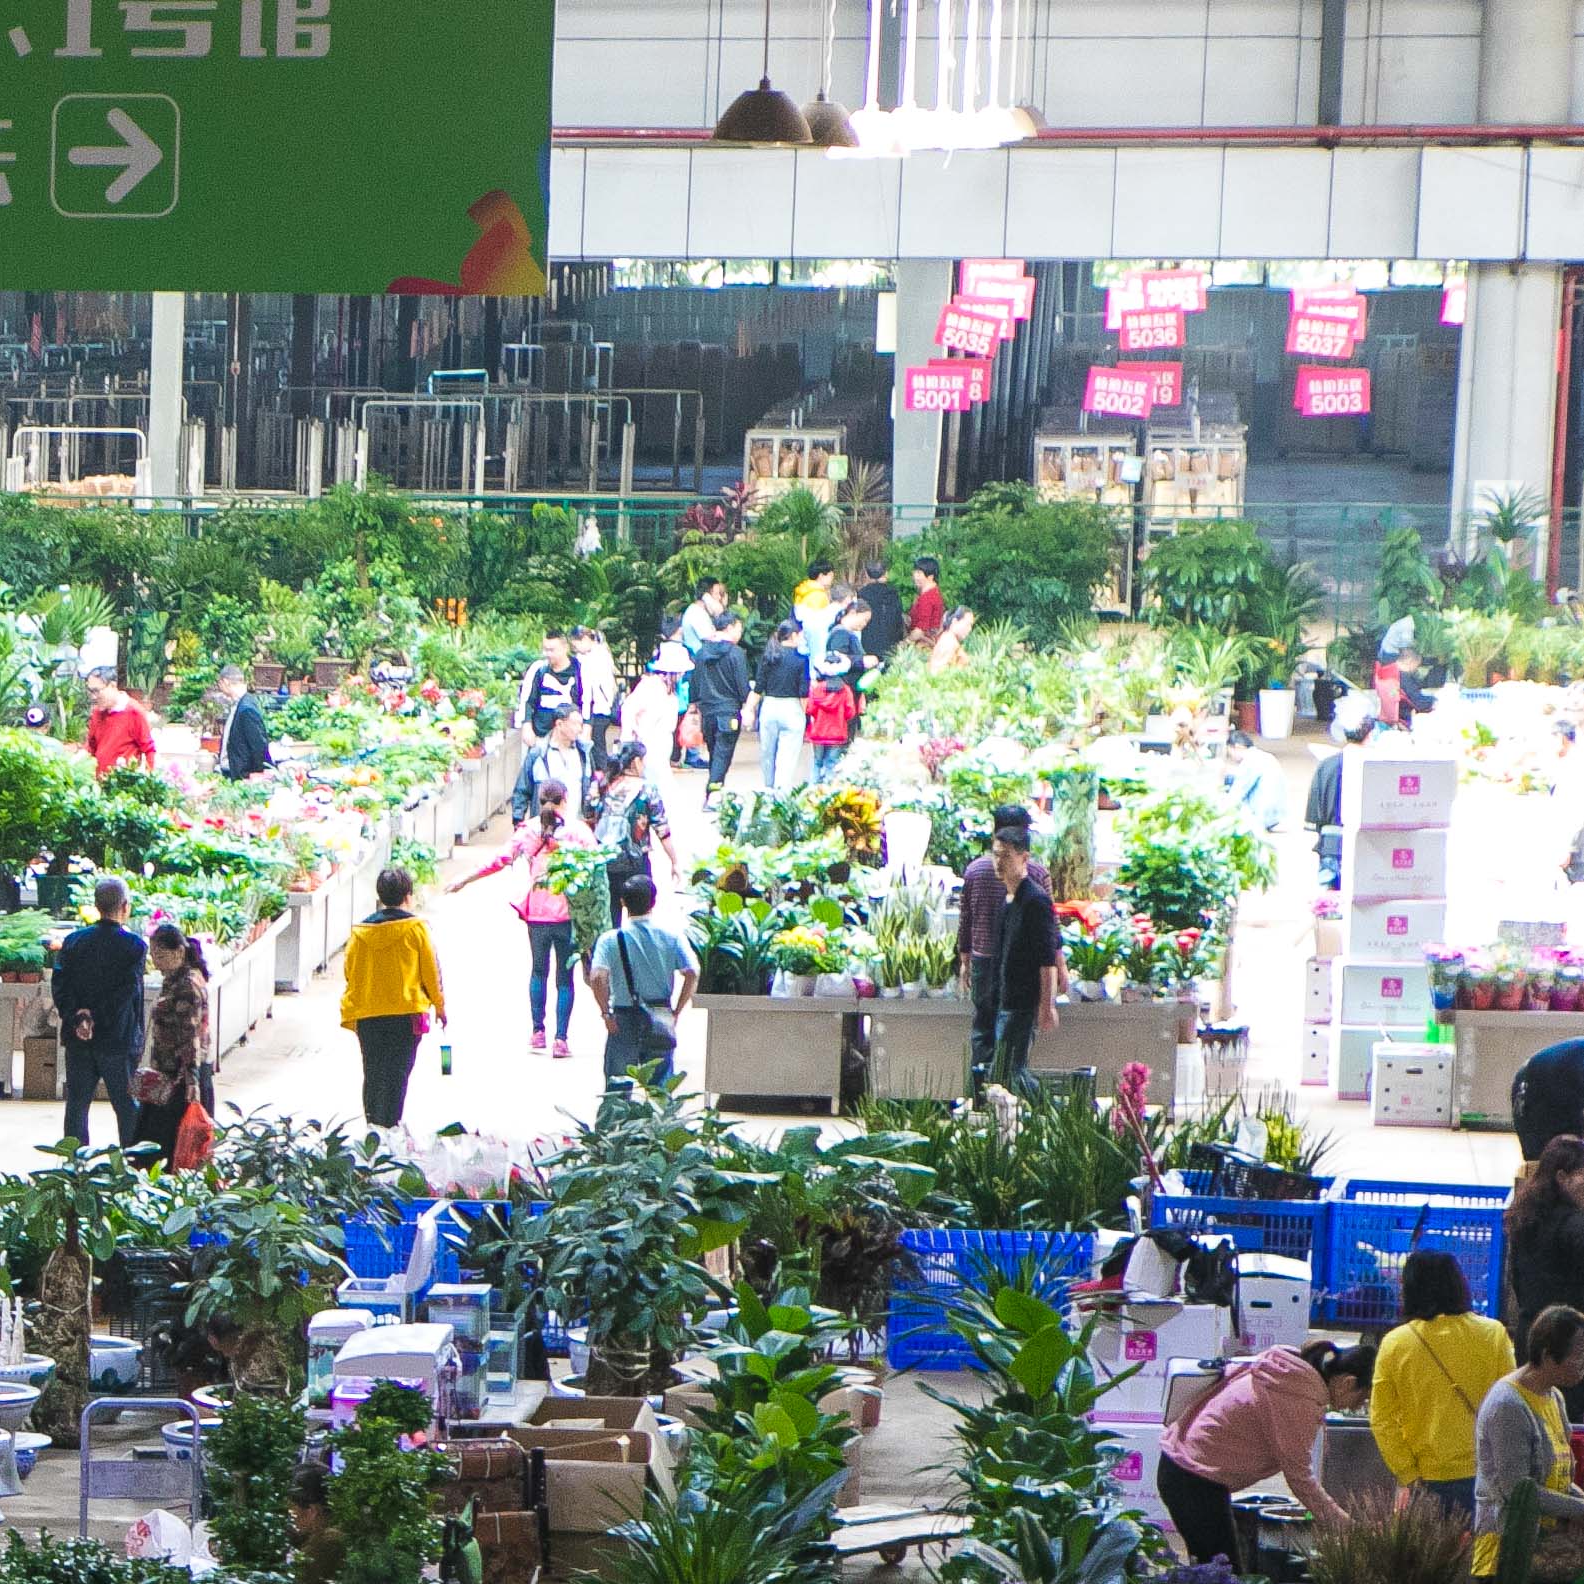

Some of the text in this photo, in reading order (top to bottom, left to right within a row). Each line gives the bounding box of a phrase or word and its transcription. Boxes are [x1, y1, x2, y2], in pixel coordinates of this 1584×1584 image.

[943, 328, 991, 355] 5035
[1128, 327, 1177, 349] 5036
[1296, 334, 1346, 356] 5037
[913, 390, 961, 408] 5001
[1093, 391, 1145, 416] 5002
[1311, 393, 1362, 413] 5003
